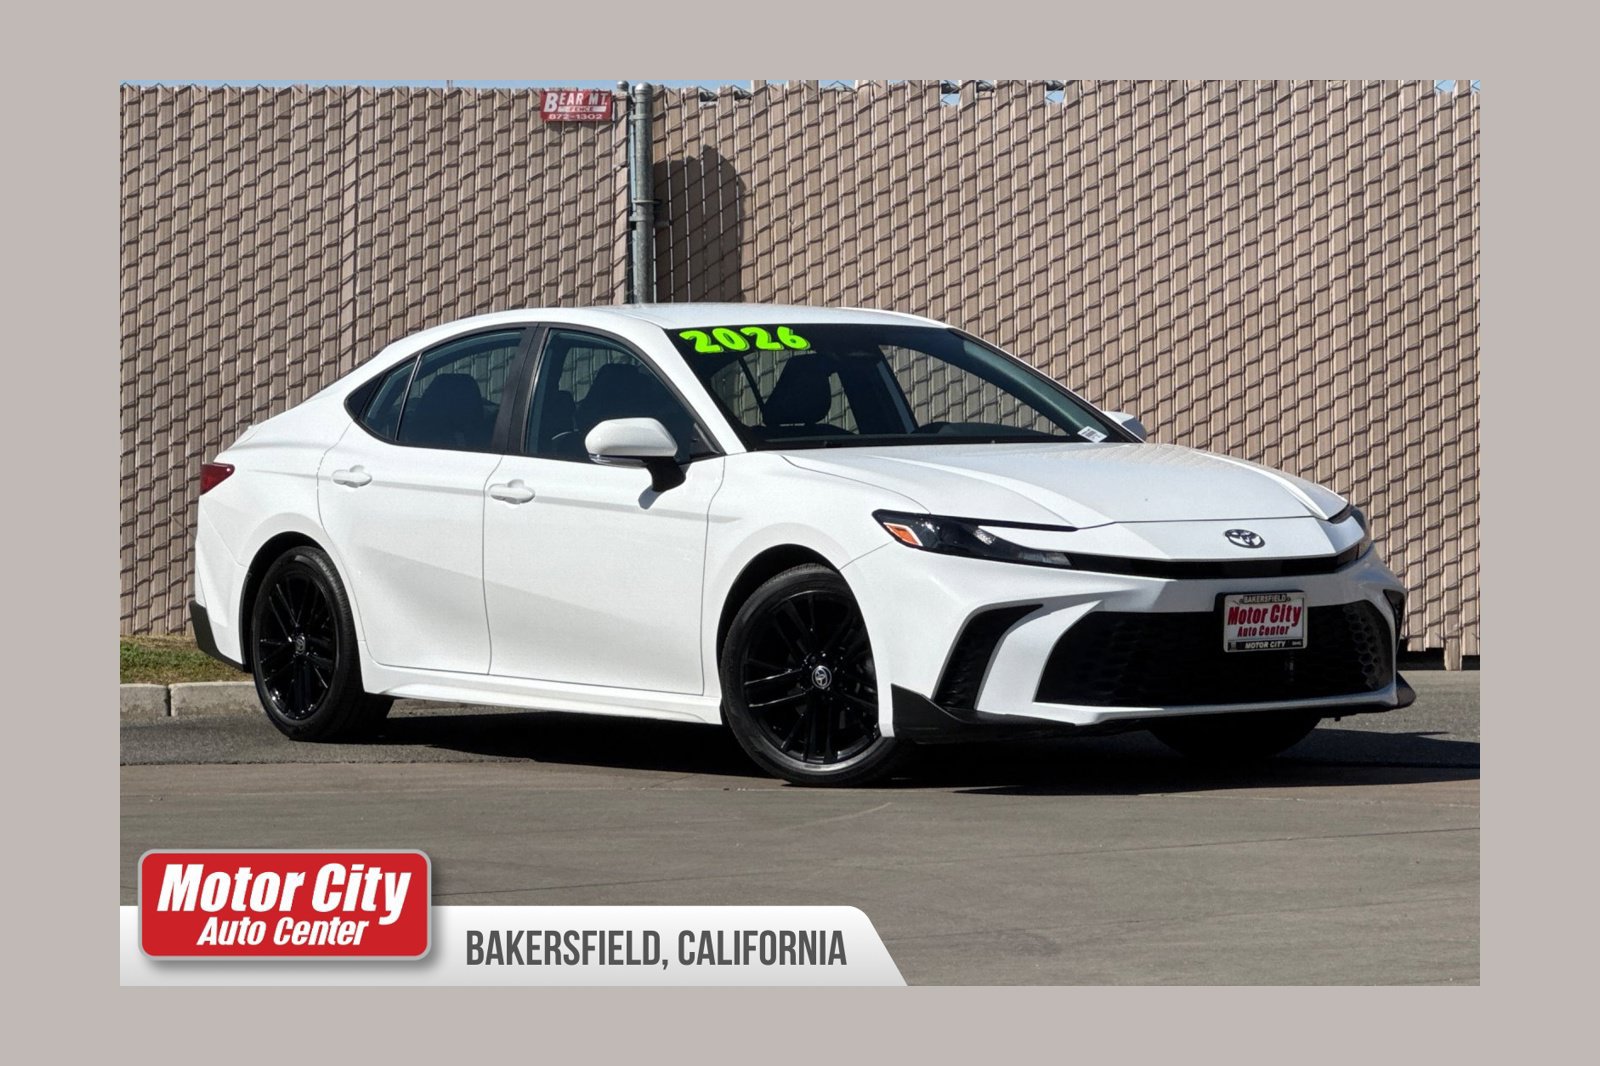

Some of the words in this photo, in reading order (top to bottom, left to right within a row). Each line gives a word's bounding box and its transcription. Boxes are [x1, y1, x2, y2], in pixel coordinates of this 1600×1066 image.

[543, 92, 584, 112] BEAR
[679, 326, 811, 353] 2026
[1227, 606, 1268, 626] Motor
[1270, 604, 1302, 627] City
[1237, 626, 1257, 637] Auto
[1259, 625, 1289, 636] Center
[1245, 641, 1269, 649] MOTOR
